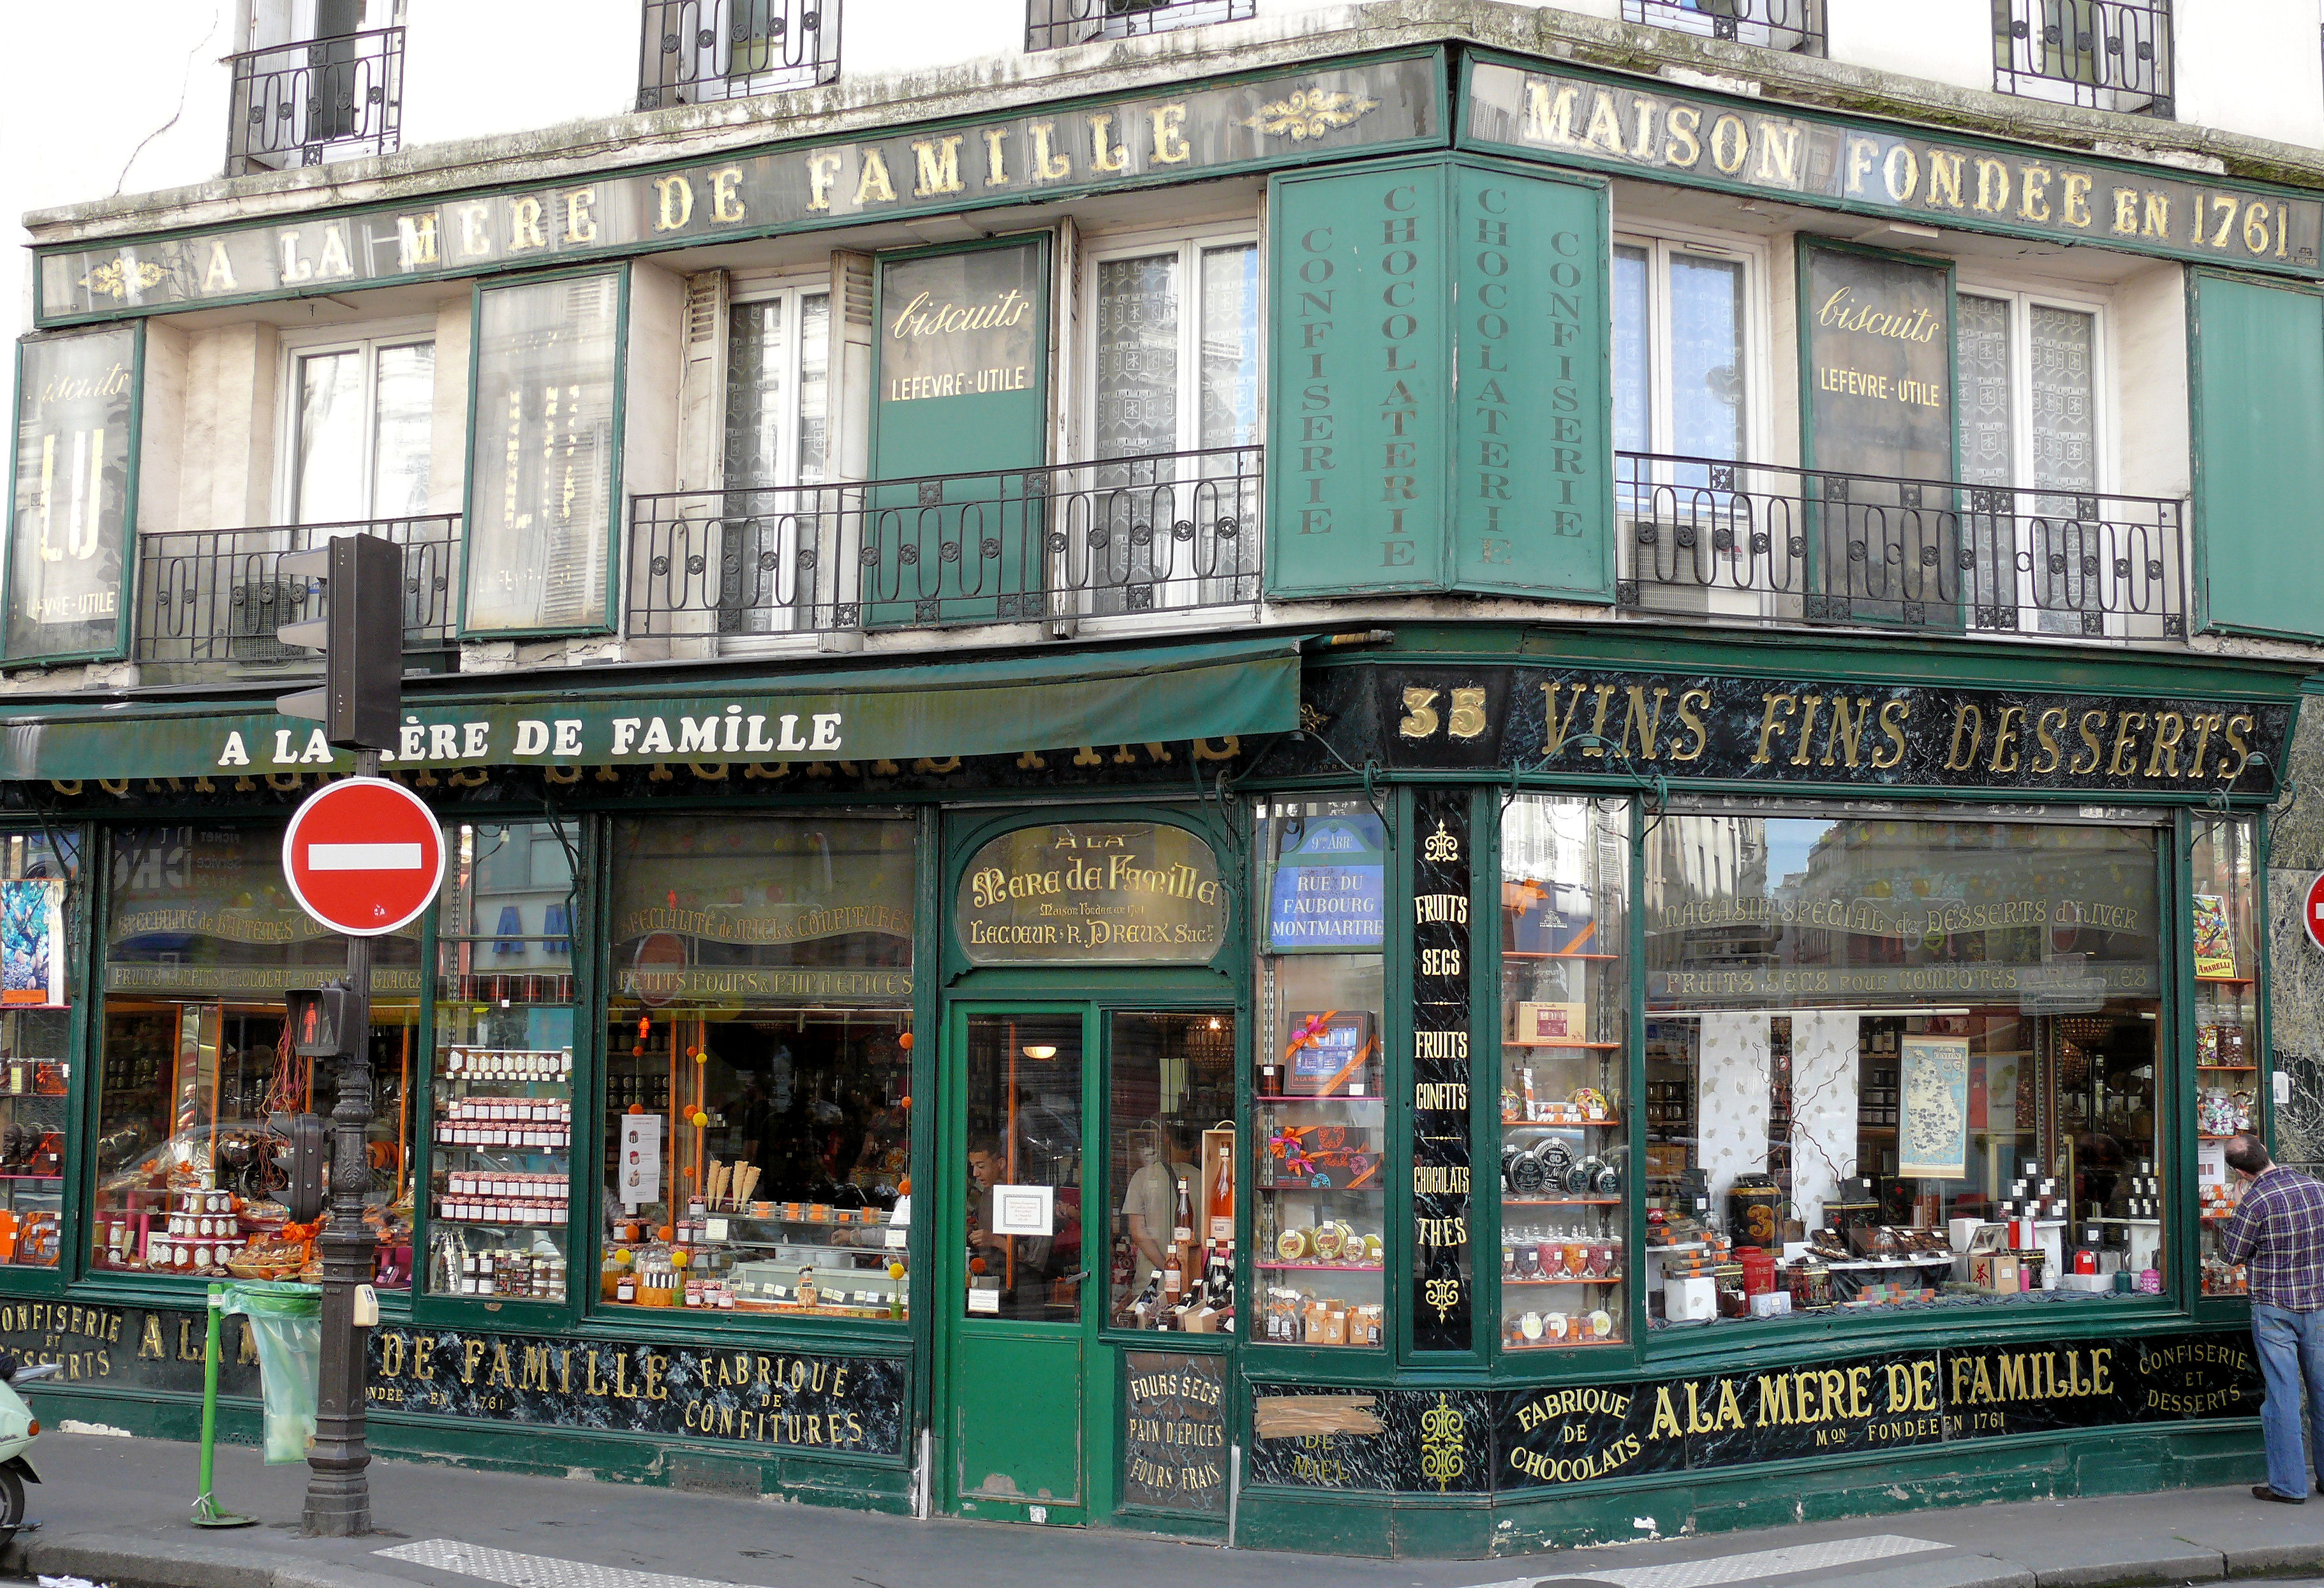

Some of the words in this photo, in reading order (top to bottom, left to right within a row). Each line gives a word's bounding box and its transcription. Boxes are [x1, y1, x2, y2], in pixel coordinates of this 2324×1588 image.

[1526, 80, 1799, 185] MAISON
[1845, 128, 2094, 228] FONDÉE
[2112, 186, 2170, 240] EN
[2193, 191, 2290, 259] 1761
[202, 240, 238, 293] A
[280, 225, 355, 286] LA
[653, 165, 746, 234] DE
[805, 102, 1190, 212] FAMILLE
[891, 289, 1030, 339] biscuits
[1816, 286, 1939, 345] biscuits
[1296, 228, 1335, 535] CONFISERIE
[1379, 185, 1419, 567] CHOCOLATERIE
[1474, 188, 1512, 565] CHOCOLATERIE
[1546, 231, 1585, 539] CONFISERIE
[40, 428, 105, 563] LU
[1400, 686, 1487, 739] 35
[218, 731, 251, 766] A
[272, 729, 334, 764] LA
[512, 720, 582, 757] DE
[1539, 680, 1712, 762] VINS
[1750, 692, 1911, 769] FINS
[1944, 703, 2255, 780] DESSERTS
[1086, 835, 1125, 849] LA
[1067, 855, 1103, 892] de
[1298, 875, 1330, 893] RUE
[1342, 875, 1364, 891] DU
[1284, 897, 1375, 914] FAUBOURG
[1414, 894, 1468, 926] FRUITS
[1658, 896, 1772, 930] MAGASIN
[1925, 898, 2048, 933] DESSERTS
[1272, 919, 1384, 937] MONTMARTRE
[114, 967, 161, 986] FRUITS
[225, 969, 293, 988] CHOCOLAT
[1421, 948, 1461, 976] SECS
[2198, 961, 2231, 974] AMARELLI
[618, 970, 687, 992] PETITS
[1666, 970, 1755, 995] FRUITS
[1898, 967, 2018, 991] COMPOTES
[1414, 1030, 1468, 1059] FRUITS
[1416, 1082, 1467, 1111] CONFITS
[1413, 1166, 1470, 1194] CHOCOLATS
[1418, 1215, 1467, 1247] THÉS
[1746, 1204, 1777, 1243] 3
[1, 1303, 122, 1343] ONFISERIE
[138, 1314, 165, 1358] A
[380, 1333, 435, 1380] DE
[461, 1339, 670, 1401] FAMILLE
[2140, 1344, 2249, 1374] CONFISERIE
[700, 1354, 849, 1399] FABRIQUE
[1130, 1374, 1178, 1403] FOURS
[1180, 1376, 1222, 1405] SECS
[2185, 1371, 2203, 1388] ET
[471, 1395, 505, 1412] 1761
[760, 1392, 783, 1409] DE
[1648, 1385, 1684, 1440] A
[1684, 1379, 1747, 1436] LA
[1886, 1358, 1937, 1415] DE
[1949, 1347, 2115, 1406] FAMILLE
[2147, 1383, 2240, 1414] DESSERTS
[685, 1399, 864, 1445] CONFITURES
[1515, 1387, 1631, 1434] FABRIQUE
[1943, 1413, 1963, 1432] EN
[1973, 1411, 2006, 1430] 1761
[1129, 1418, 1160, 1443] PAIN
[1305, 1434, 1334, 1451] DE
[1564, 1425, 1588, 1443] DE
[1130, 1457, 1173, 1490] FOURS
[1181, 1462, 1222, 1490] FRAIS
[1291, 1455, 1351, 1483] MIEL
[1509, 1432, 1642, 1483] CHOCOLATS
